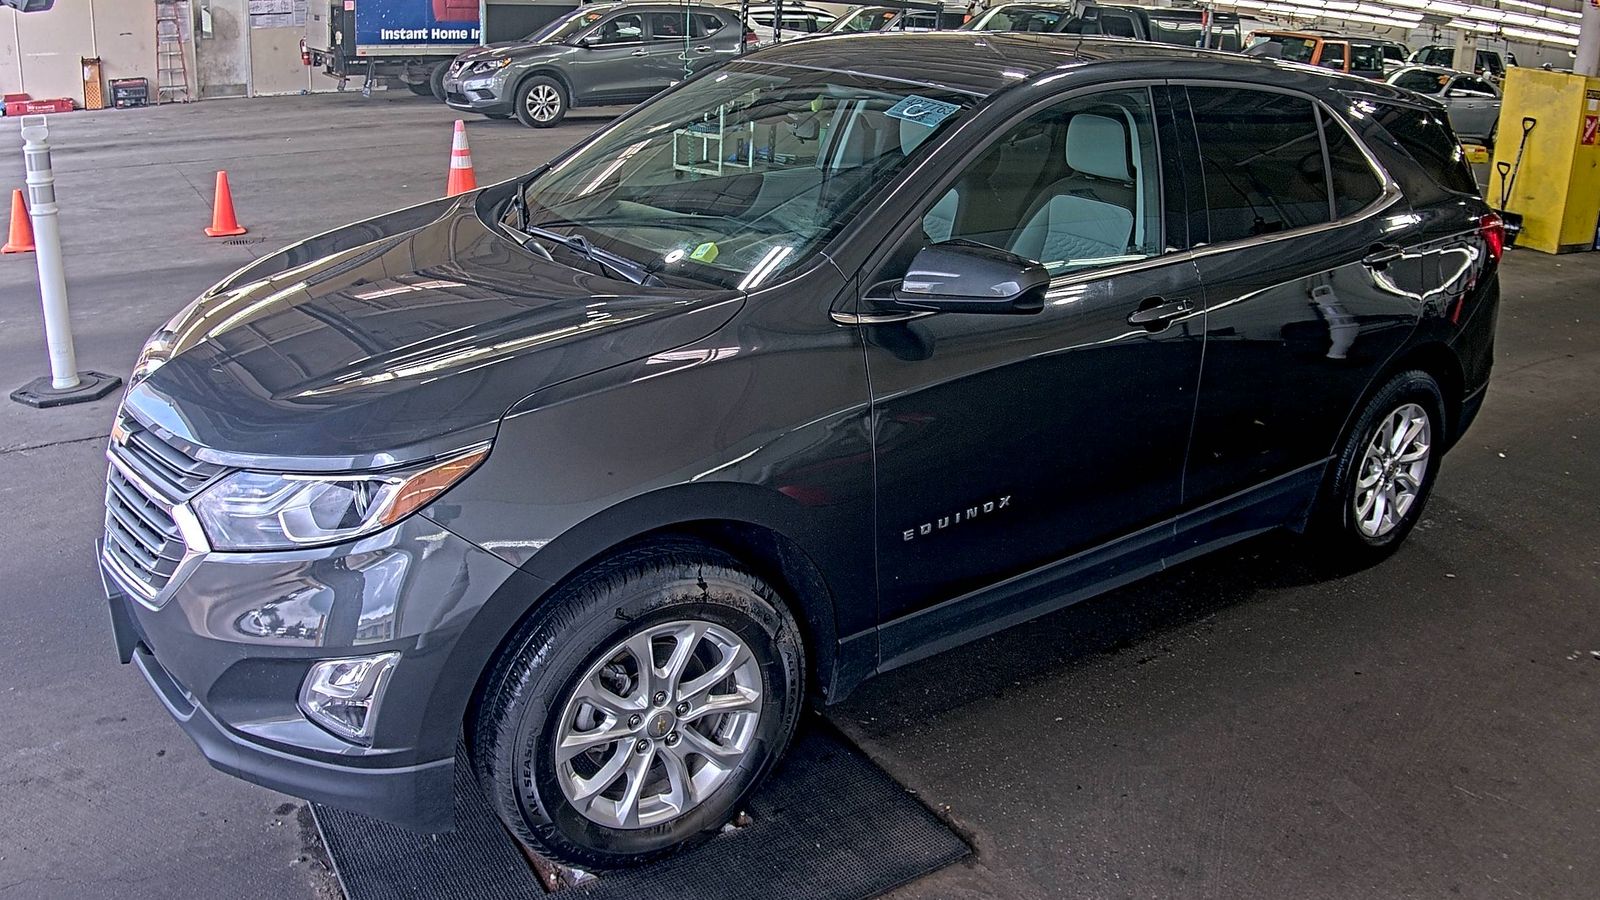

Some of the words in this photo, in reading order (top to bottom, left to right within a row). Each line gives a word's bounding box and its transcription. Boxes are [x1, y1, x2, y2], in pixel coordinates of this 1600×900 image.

[381, 28, 428, 40] Instant
[431, 28, 468, 40] Home
[902, 495, 1011, 542] EQUINOX
[523, 728, 538, 788] SEASON
[527, 791, 541, 817] ALL
